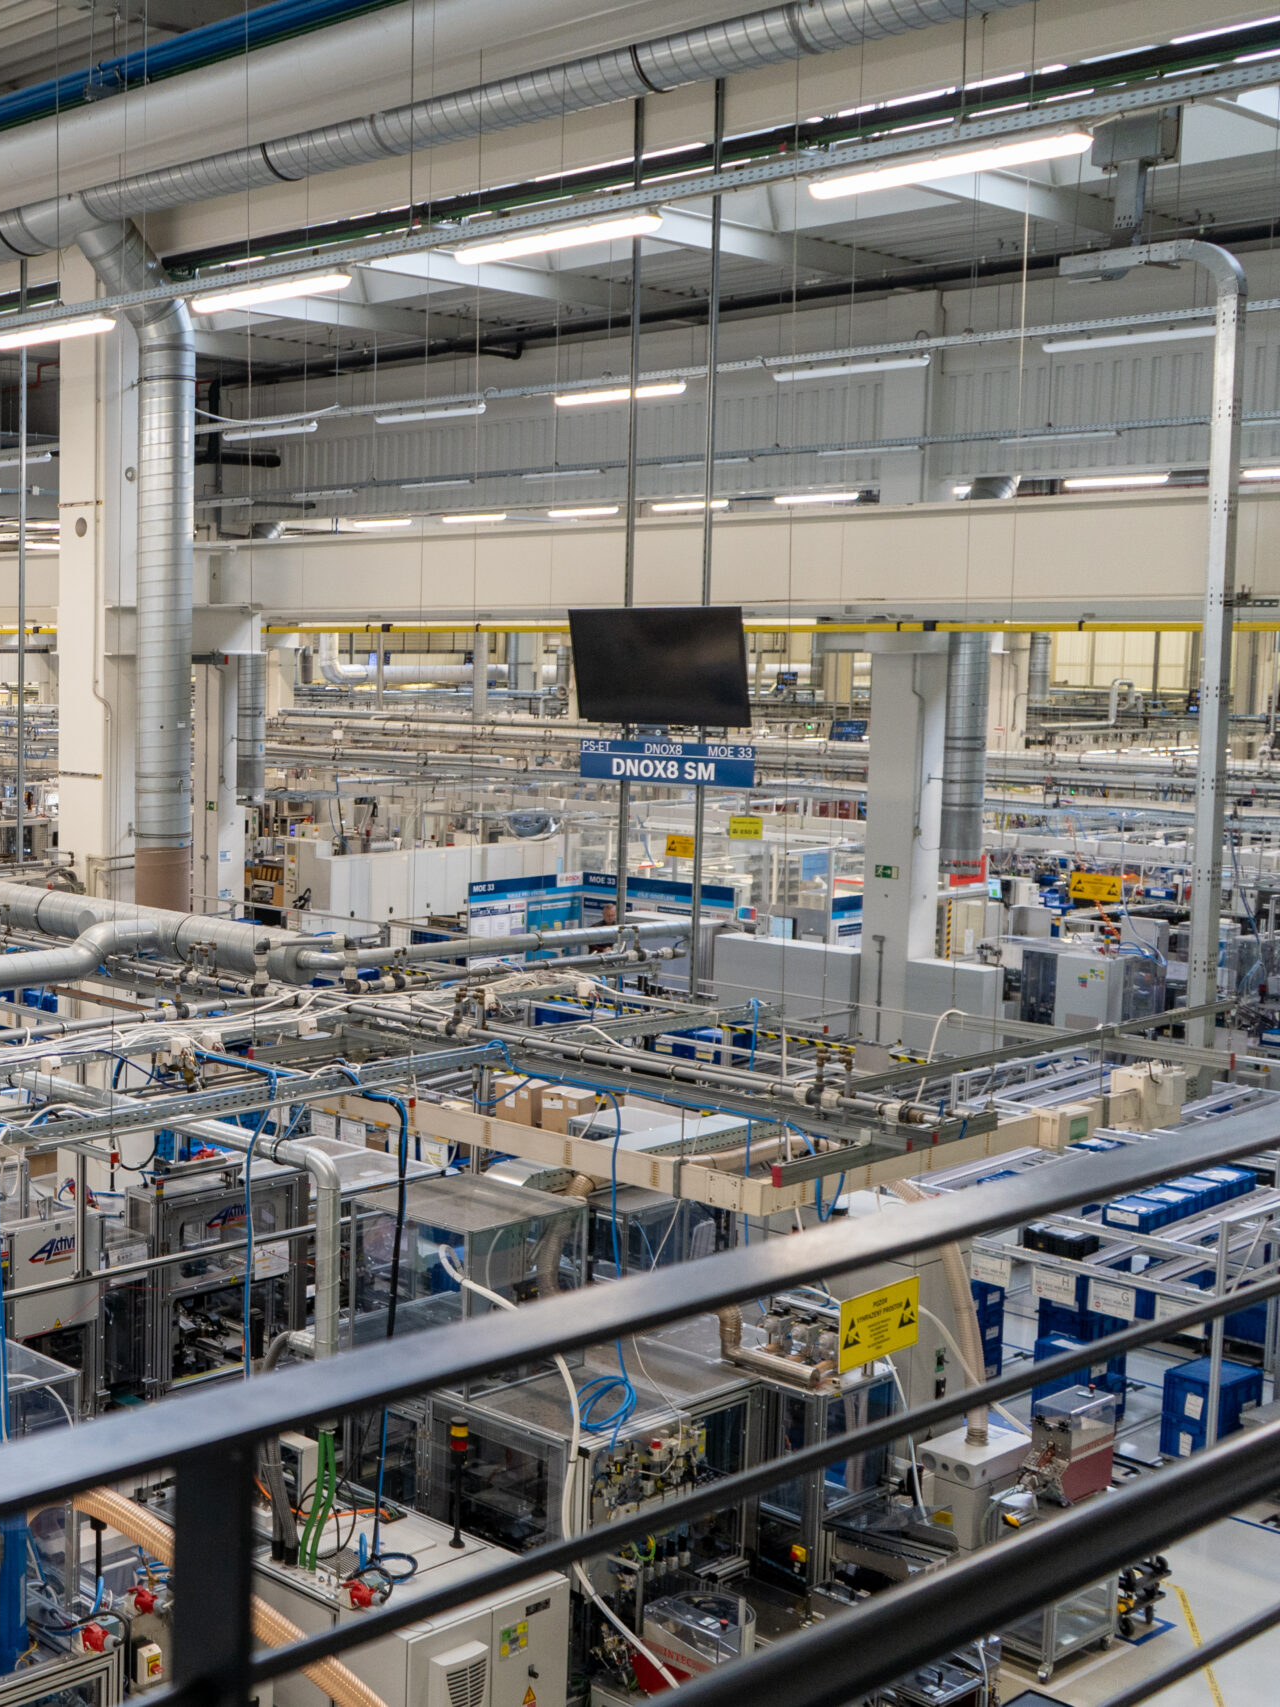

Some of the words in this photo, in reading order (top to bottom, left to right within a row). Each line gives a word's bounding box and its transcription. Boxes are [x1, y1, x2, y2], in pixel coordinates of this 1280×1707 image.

[581, 740, 611, 752] PS-ET
[644, 743, 683, 756] DNOX8
[708, 745, 735, 758] MOE
[737, 746, 753, 758] 33
[611, 757, 680, 779] DNOX8
[683, 761, 716, 781] SM
[472, 884, 487, 893] MOE
[486, 883, 495, 891] 33
[589, 875, 606, 885] MOE
[607, 877, 616, 886] 33
[206, 1203, 247, 1229] Aktiv
[28, 1234, 76, 1264] Aktivi
[1061, 1276, 1070, 1287] H
[1121, 1291, 1130, 1303] G
[663, 1647, 692, 1667] INTEC
